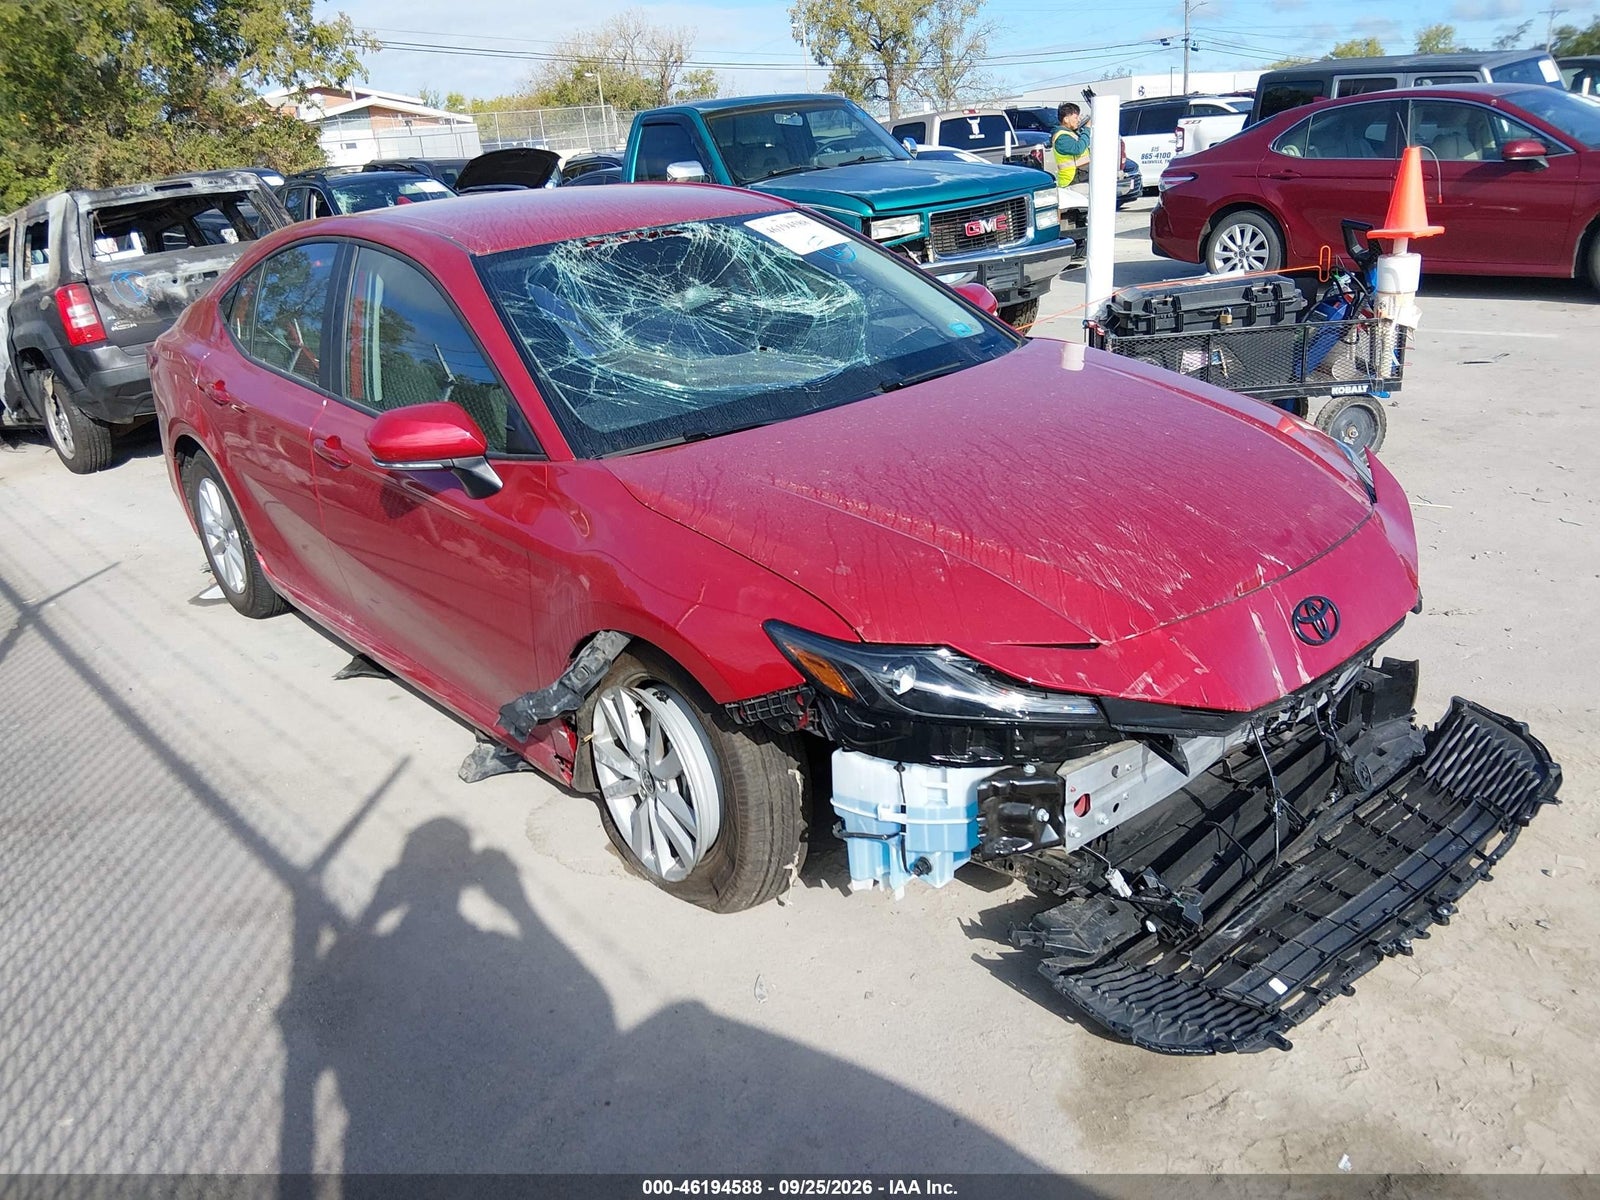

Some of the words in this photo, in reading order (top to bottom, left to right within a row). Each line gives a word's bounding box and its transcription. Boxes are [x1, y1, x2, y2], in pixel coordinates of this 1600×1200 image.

[1141, 152, 1171, 160] 865-4100
[965, 214, 1007, 236] GMC
[1331, 384, 1369, 395] KOBALT
